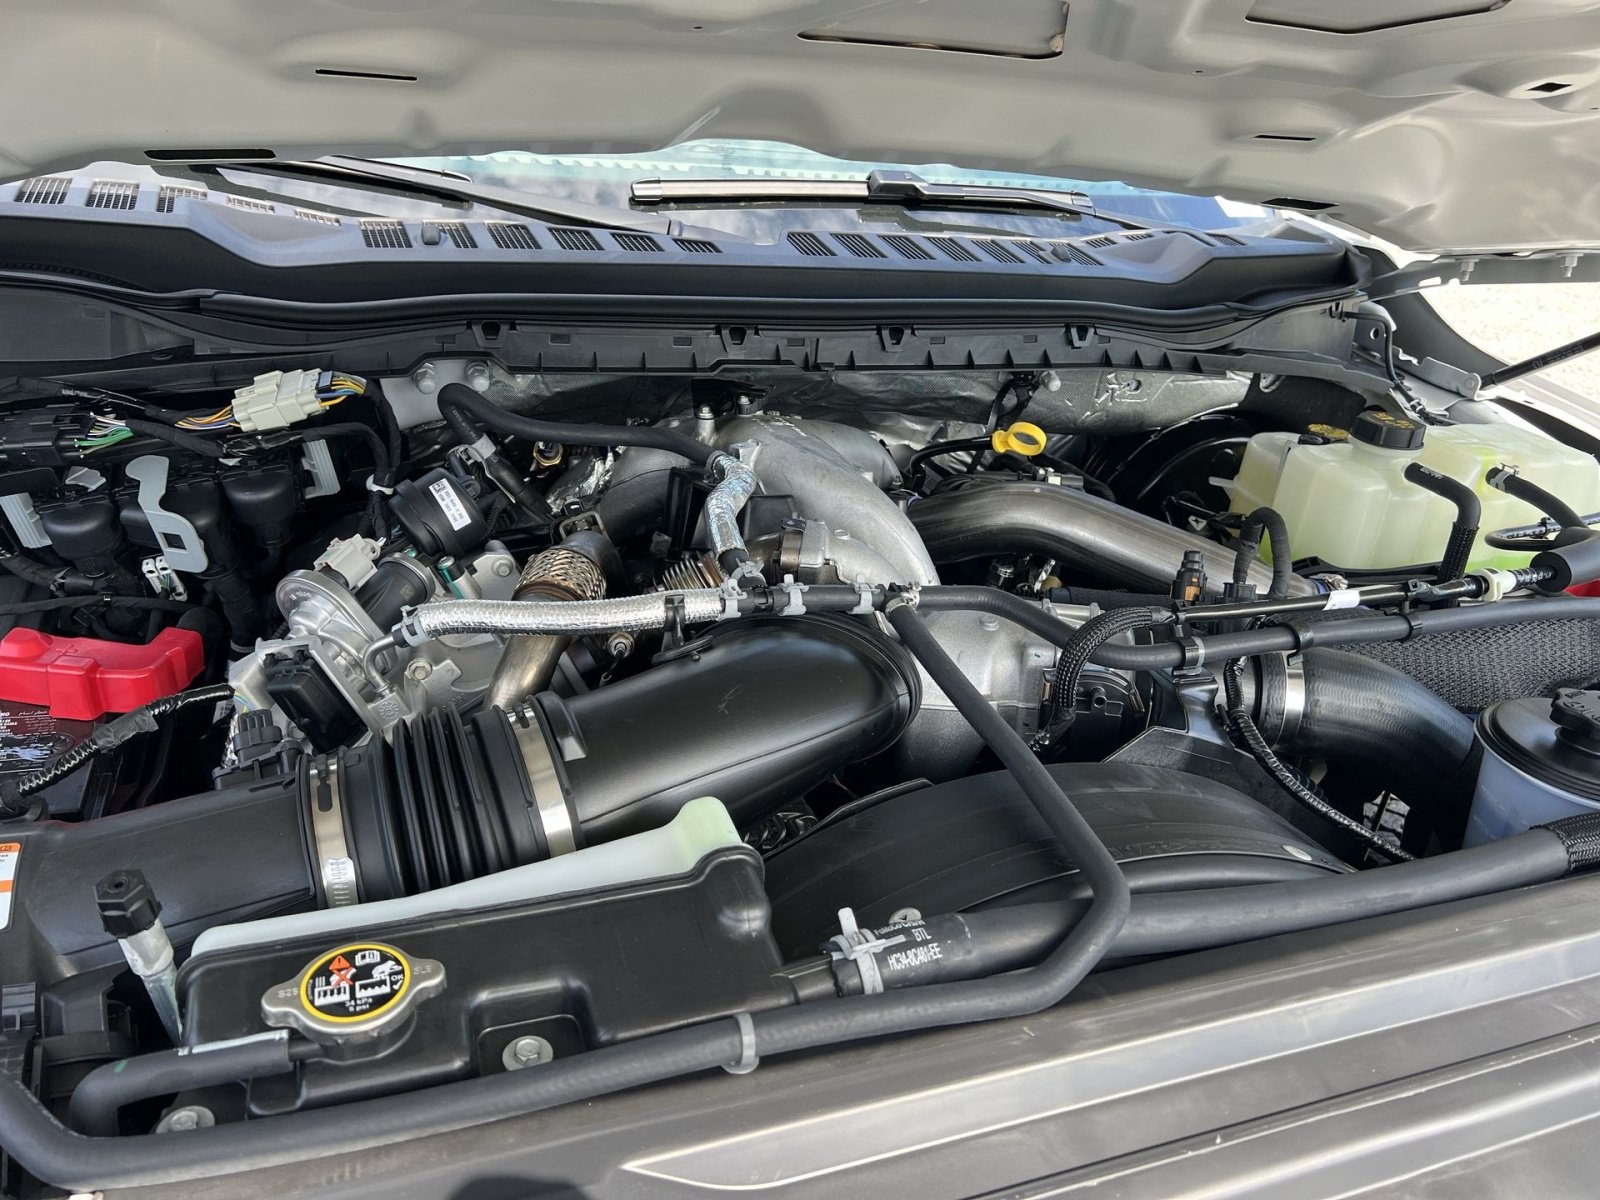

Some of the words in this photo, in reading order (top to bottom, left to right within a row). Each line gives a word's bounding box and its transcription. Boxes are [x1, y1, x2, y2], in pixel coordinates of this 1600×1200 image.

[911, 928, 932, 942] BTL
[391, 974, 404, 982] OK
[356, 997, 373, 1005] kPa
[356, 1003, 370, 1012] psi
